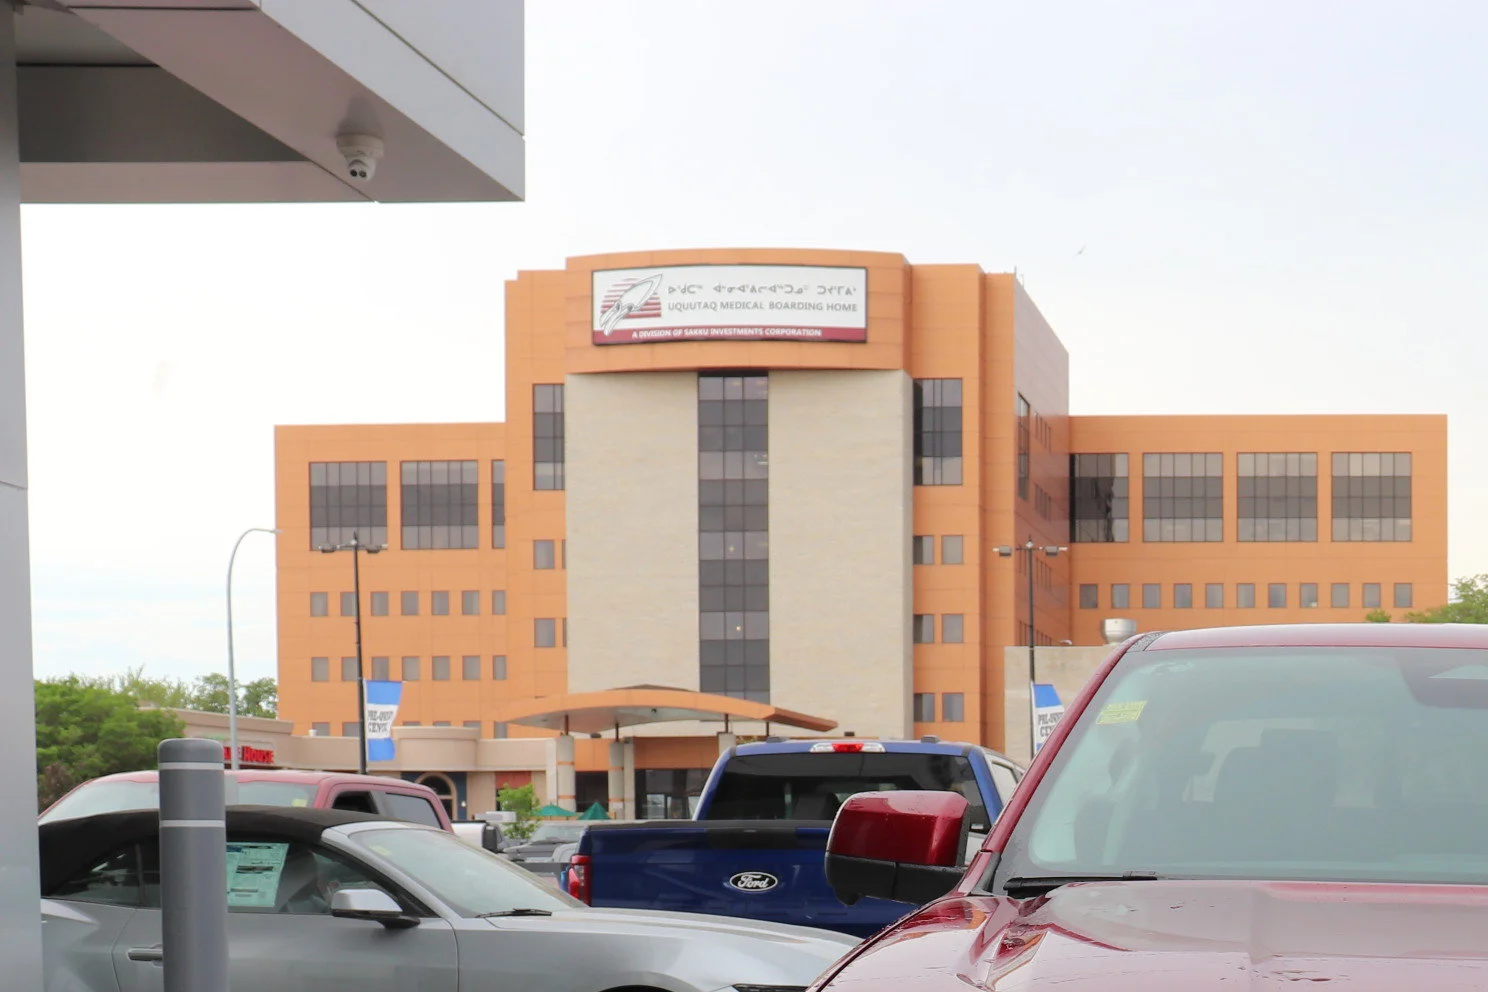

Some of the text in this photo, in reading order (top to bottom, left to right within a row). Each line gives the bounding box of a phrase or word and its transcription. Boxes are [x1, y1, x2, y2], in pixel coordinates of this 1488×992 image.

[667, 300, 858, 312] UQUUTAQ MEDICAL BOARDING HOME
[631, 330, 638, 338] A
[639, 329, 672, 337] DIVISION
[673, 328, 683, 336] OF
[711, 327, 763, 336] INVESTMENTS
[765, 328, 822, 337] CORPORATION
[737, 874, 770, 889] Ford
